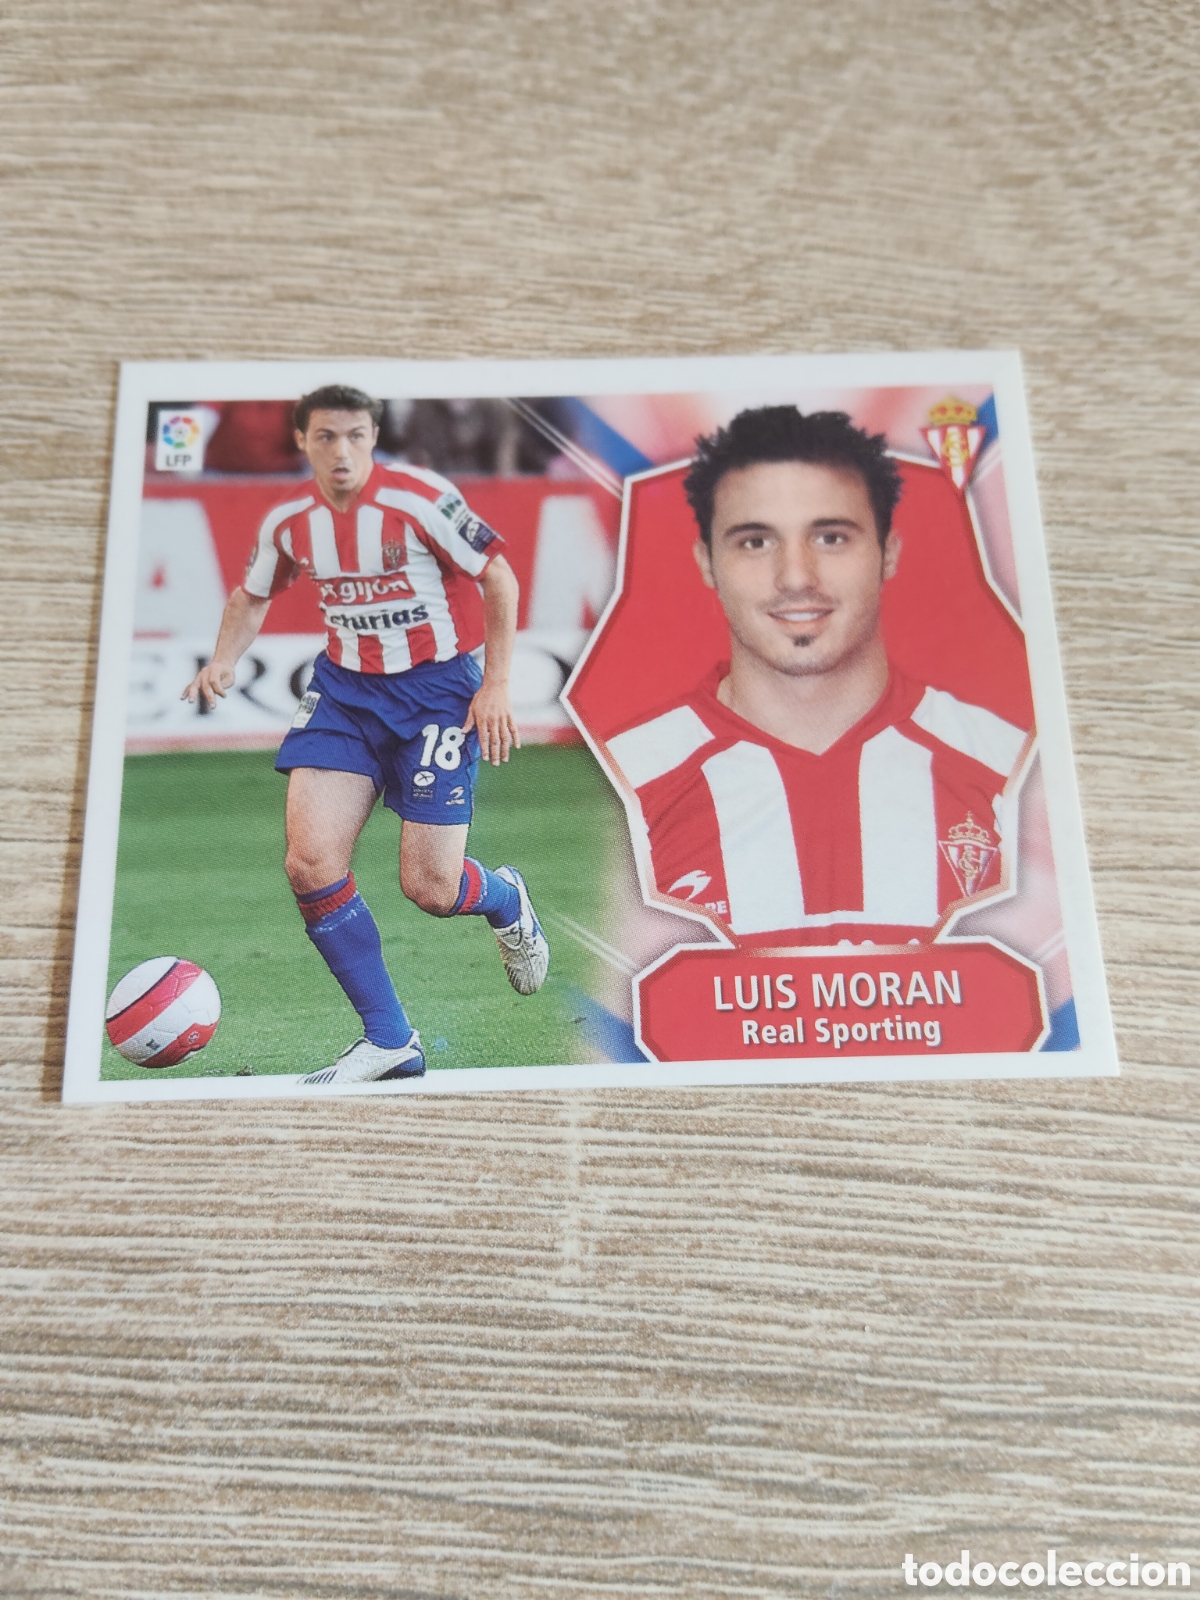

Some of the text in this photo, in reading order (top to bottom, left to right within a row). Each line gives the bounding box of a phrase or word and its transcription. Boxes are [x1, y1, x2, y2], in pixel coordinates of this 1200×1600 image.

[165, 454, 192, 468] LFP
[419, 723, 467, 771] 18
[713, 969, 964, 1011] LUIS MORAN
[741, 1014, 943, 1049] Real Sporting
